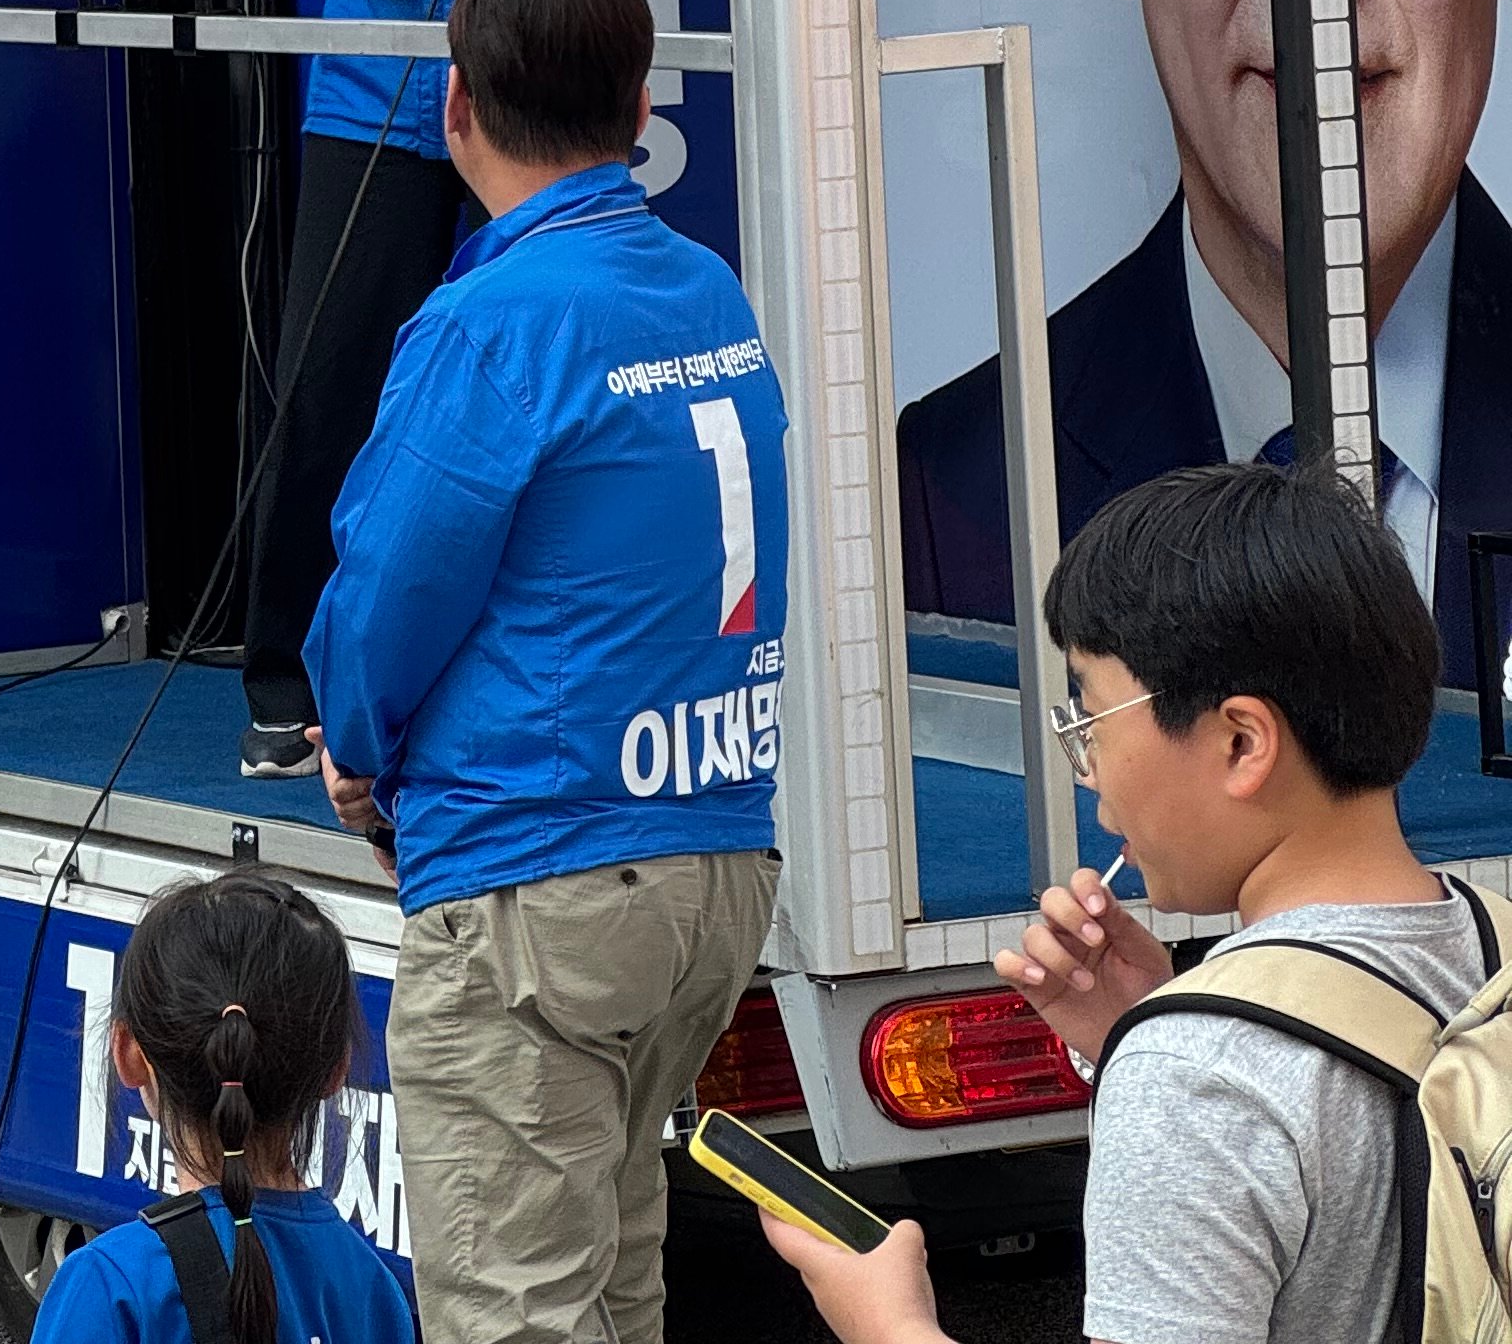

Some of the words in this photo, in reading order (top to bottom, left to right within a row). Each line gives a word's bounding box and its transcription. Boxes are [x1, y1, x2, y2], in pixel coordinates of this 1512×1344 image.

[607, 357, 686, 397] 이제부터
[682, 350, 719, 387] 진짜
[714, 338, 767, 378] 대한민국
[692, 397, 756, 637] 1
[746, 639, 784, 676] 지금
[621, 678, 784, 797] 이재명
